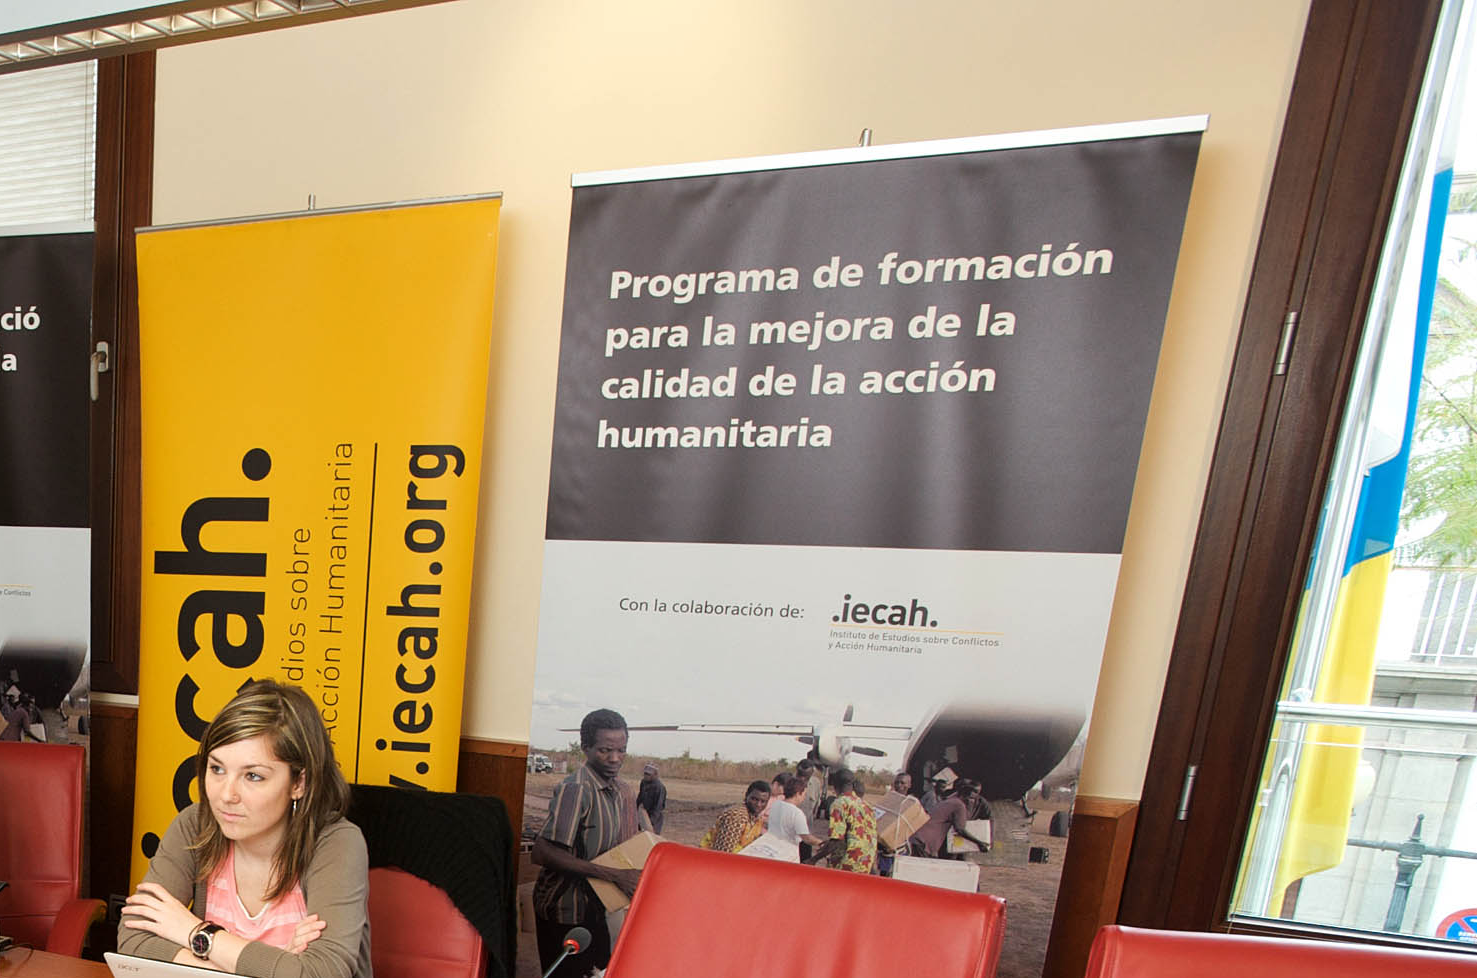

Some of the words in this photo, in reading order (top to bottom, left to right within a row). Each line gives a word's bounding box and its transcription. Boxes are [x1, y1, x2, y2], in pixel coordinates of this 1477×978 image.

[610, 265, 799, 304] Programa
[812, 256, 863, 290] de
[877, 242, 1114, 285] formación
[604, 321, 689, 357] para
[702, 315, 735, 347] la
[748, 311, 894, 351] mejora
[907, 306, 961, 339] de
[976, 304, 1016, 337] la
[600, 368, 738, 400] calidad
[748, 366, 797, 397] de
[810, 364, 846, 395] la
[859, 361, 996, 394] acción
[596, 417, 833, 448] humanitaria
[318, 441, 353, 633] Humanitaria
[286, 527, 311, 611] sobre
[619, 597, 649, 612] Con
[653, 598, 667, 613] la
[672, 600, 774, 618] colaboración
[778, 603, 805, 619] de:
[832, 593, 939, 628] .iecah.
[827, 642, 833, 650] y
[834, 641, 864, 651] Acción
[866, 643, 922, 654] Humanitaria
[829, 629, 866, 640] Instituto
[868, 631, 880, 641] de
[882, 632, 921, 643] Estudios
[923, 635, 949, 645] sobre
[951, 636, 1000, 647] Conflictos
